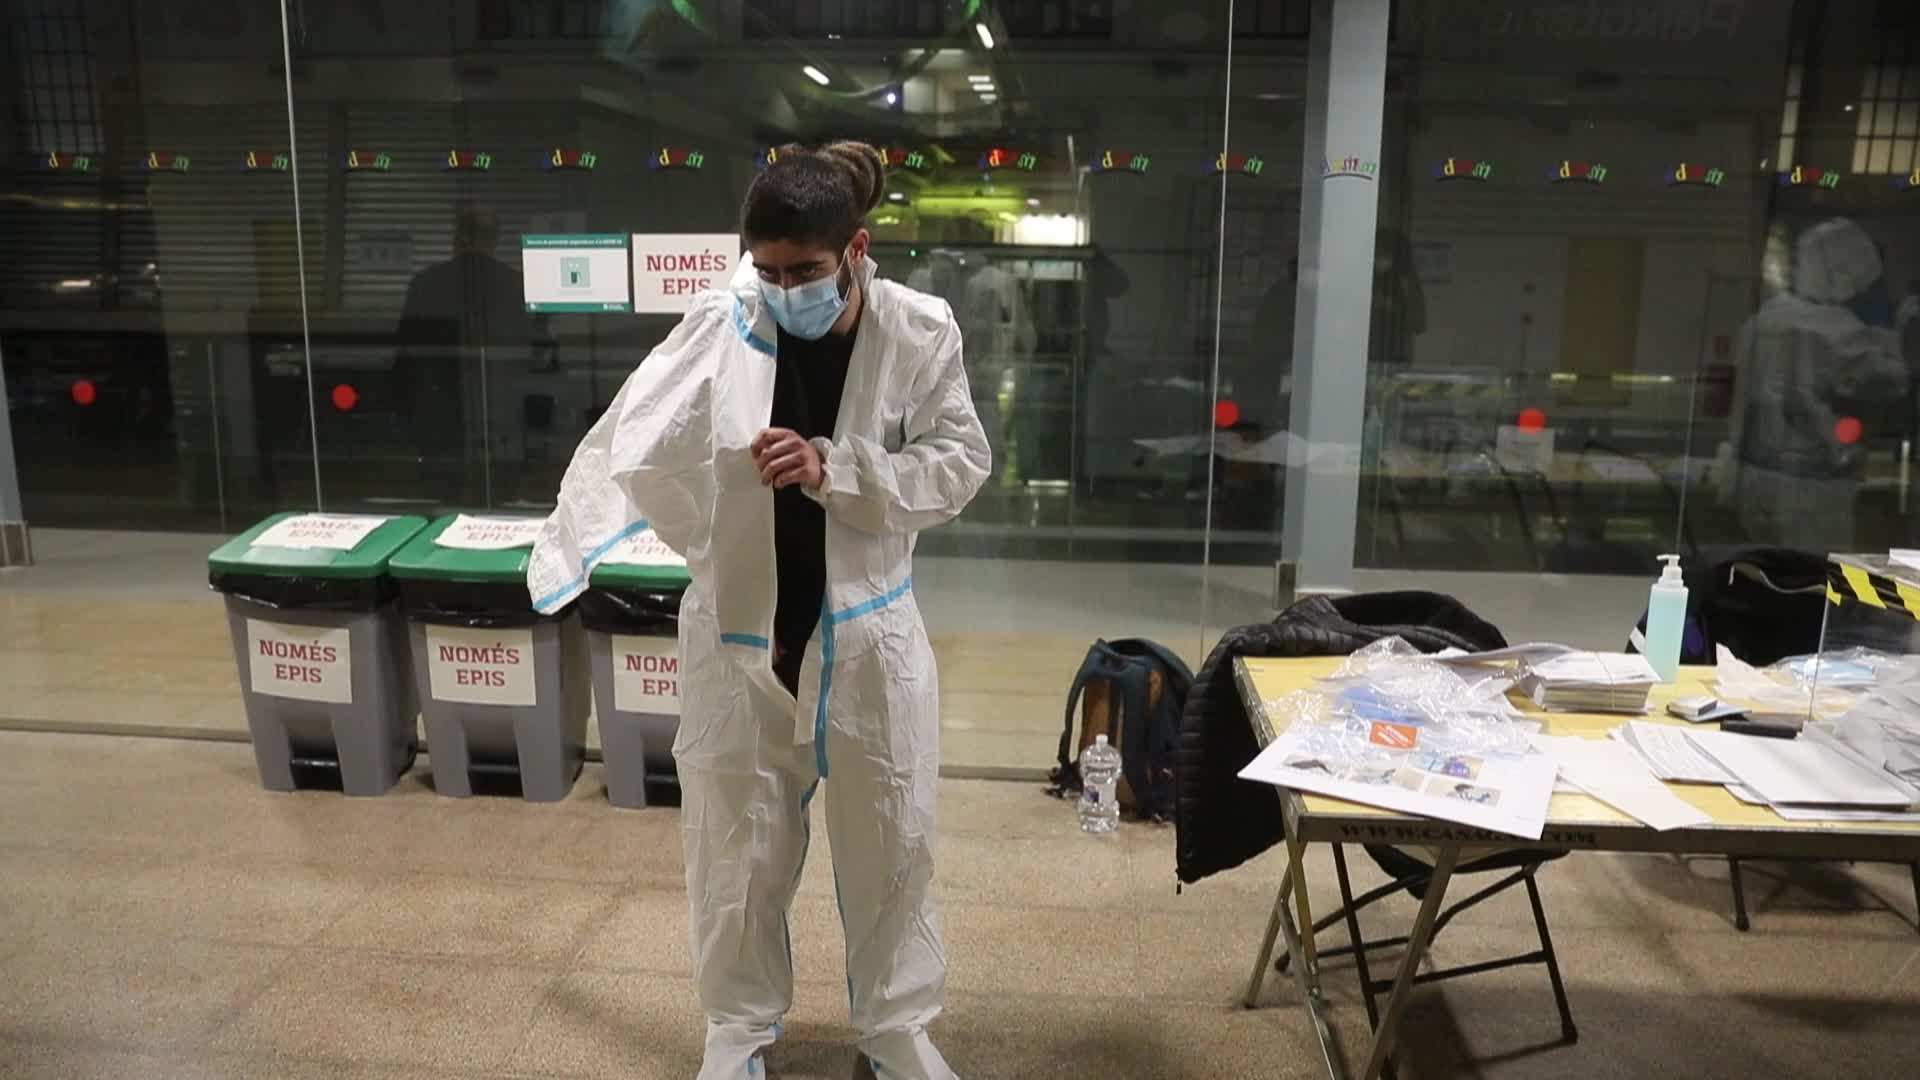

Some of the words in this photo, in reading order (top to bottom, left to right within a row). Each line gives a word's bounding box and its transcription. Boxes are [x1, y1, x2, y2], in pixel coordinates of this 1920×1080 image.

[646, 249, 727, 272] NOMÉS
[259, 639, 337, 663] NOMÉS
[439, 641, 520, 665] NOMÉS
[275, 664, 322, 684] EPIS
[625, 654, 678, 674] NOM
[456, 669, 505, 687] EPIS
[642, 679, 678, 697] EPI
